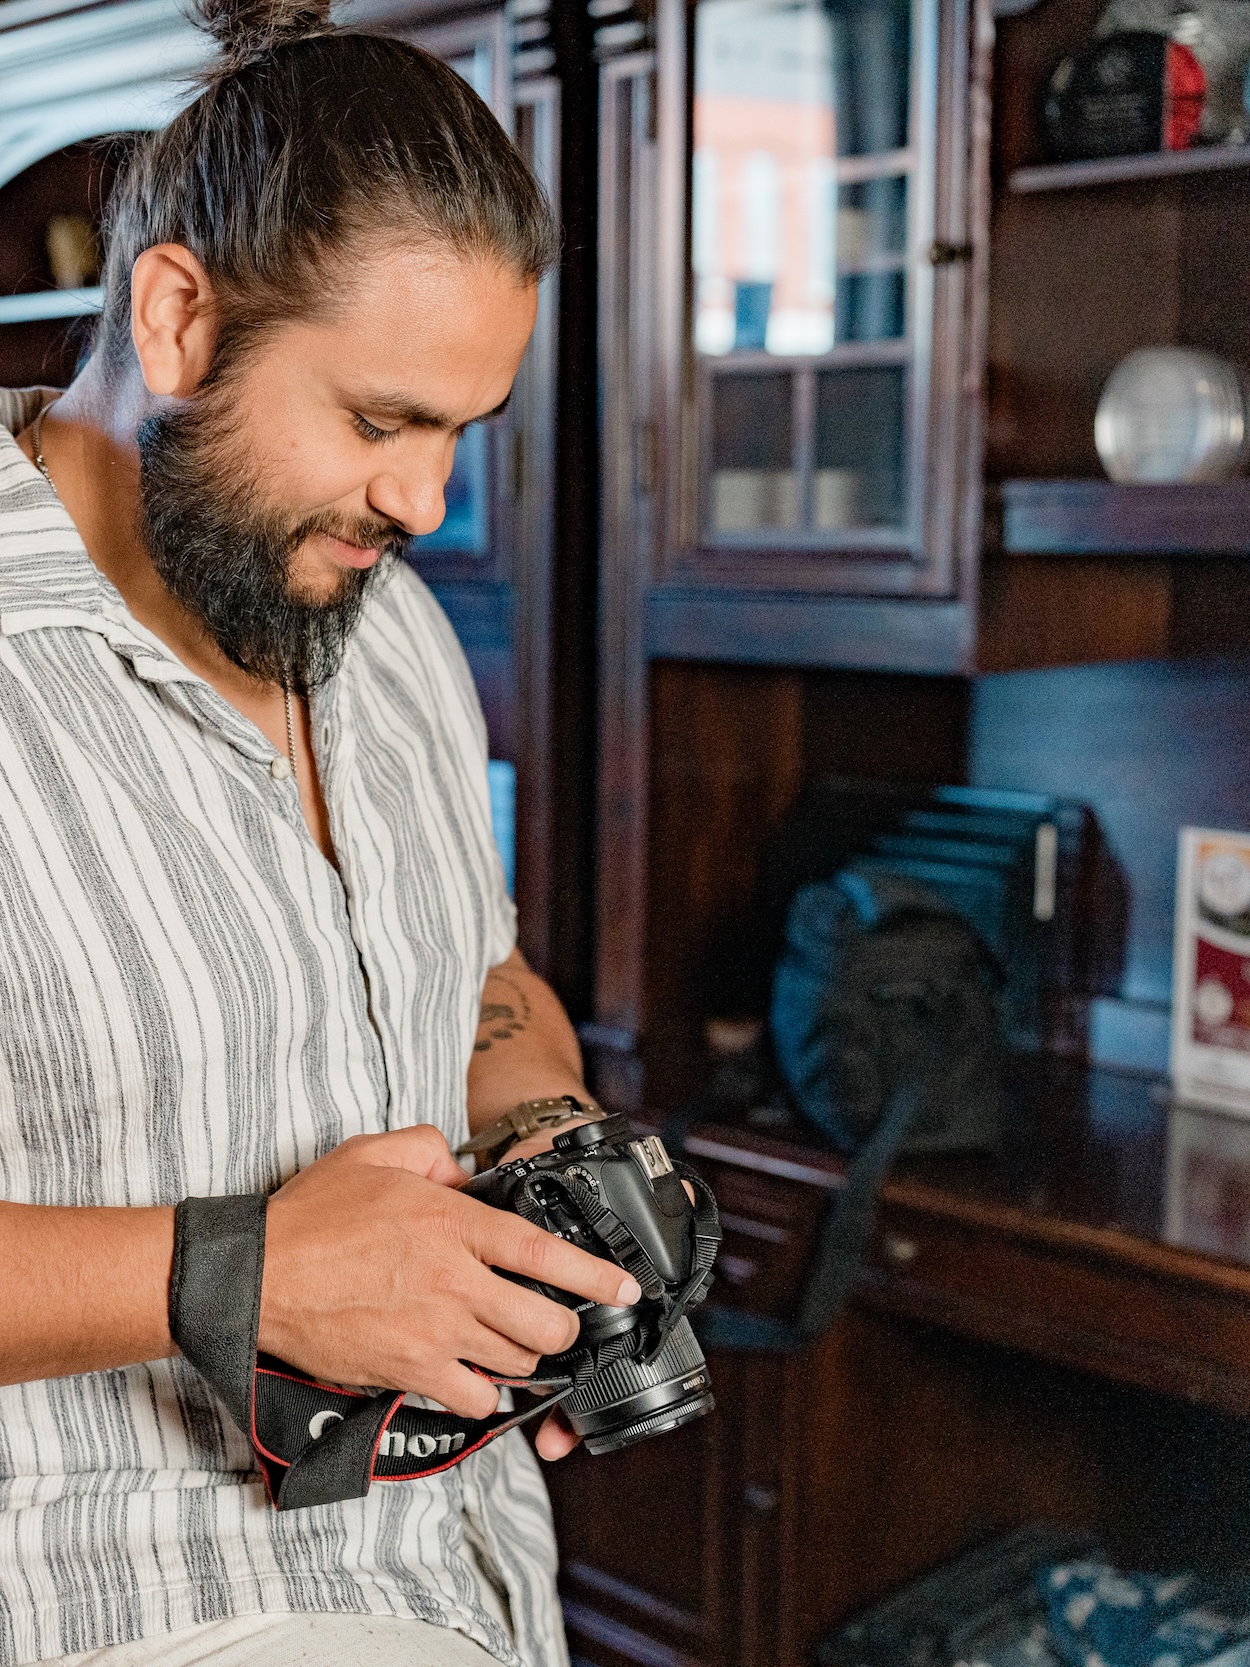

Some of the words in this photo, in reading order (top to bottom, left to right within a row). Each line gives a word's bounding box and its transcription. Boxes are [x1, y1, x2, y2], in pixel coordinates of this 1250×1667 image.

[617, 1321, 628, 1331] 55
[682, 1374, 706, 1391] Canon
[308, 1410, 465, 1458] Cnon
